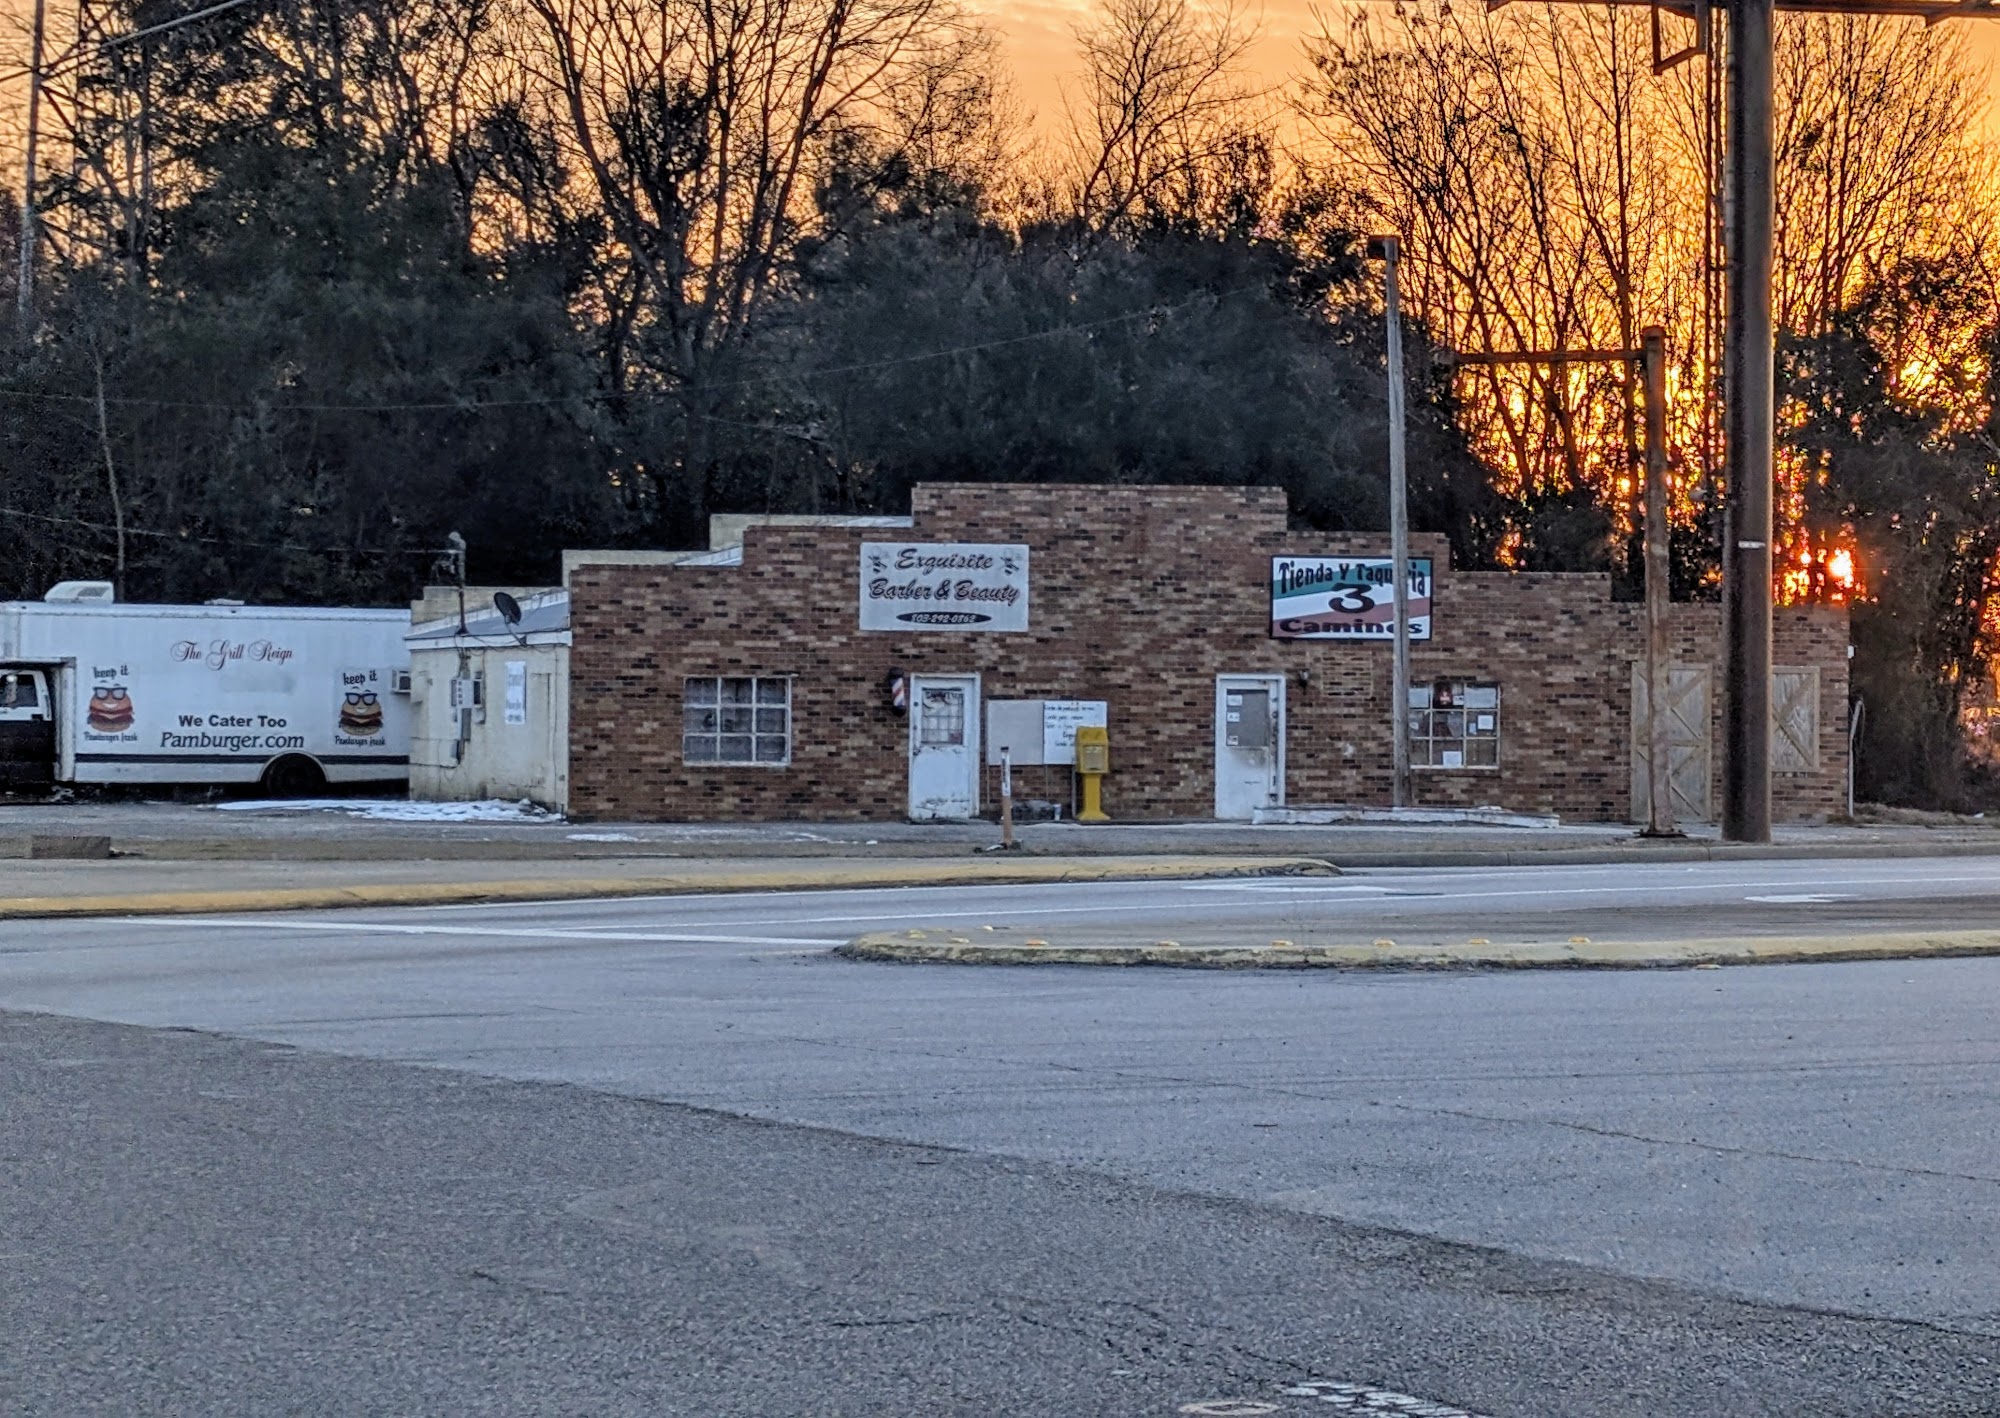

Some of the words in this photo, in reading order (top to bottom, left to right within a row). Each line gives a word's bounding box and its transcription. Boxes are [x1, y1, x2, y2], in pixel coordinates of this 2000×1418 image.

[895, 548, 994, 575] Exquisite
[869, 578, 931, 600] Barber
[933, 579, 950, 600] &
[954, 579, 1021, 606] Beauty
[1279, 560, 1333, 594] Tienda
[1339, 563, 1350, 581] Y
[1356, 562, 1425, 597] Taquia
[1328, 582, 1375, 613] 3
[170, 640, 202, 662] The
[206, 639, 245, 671] Grill
[248, 640, 293, 665] Reign
[343, 672, 365, 685] keep
[369, 670, 378, 681] it
[179, 715, 203, 727] We
[208, 715, 253, 727] Cater
[258, 715, 287, 728] Too
[160, 732, 304, 752] Pamburger.com
